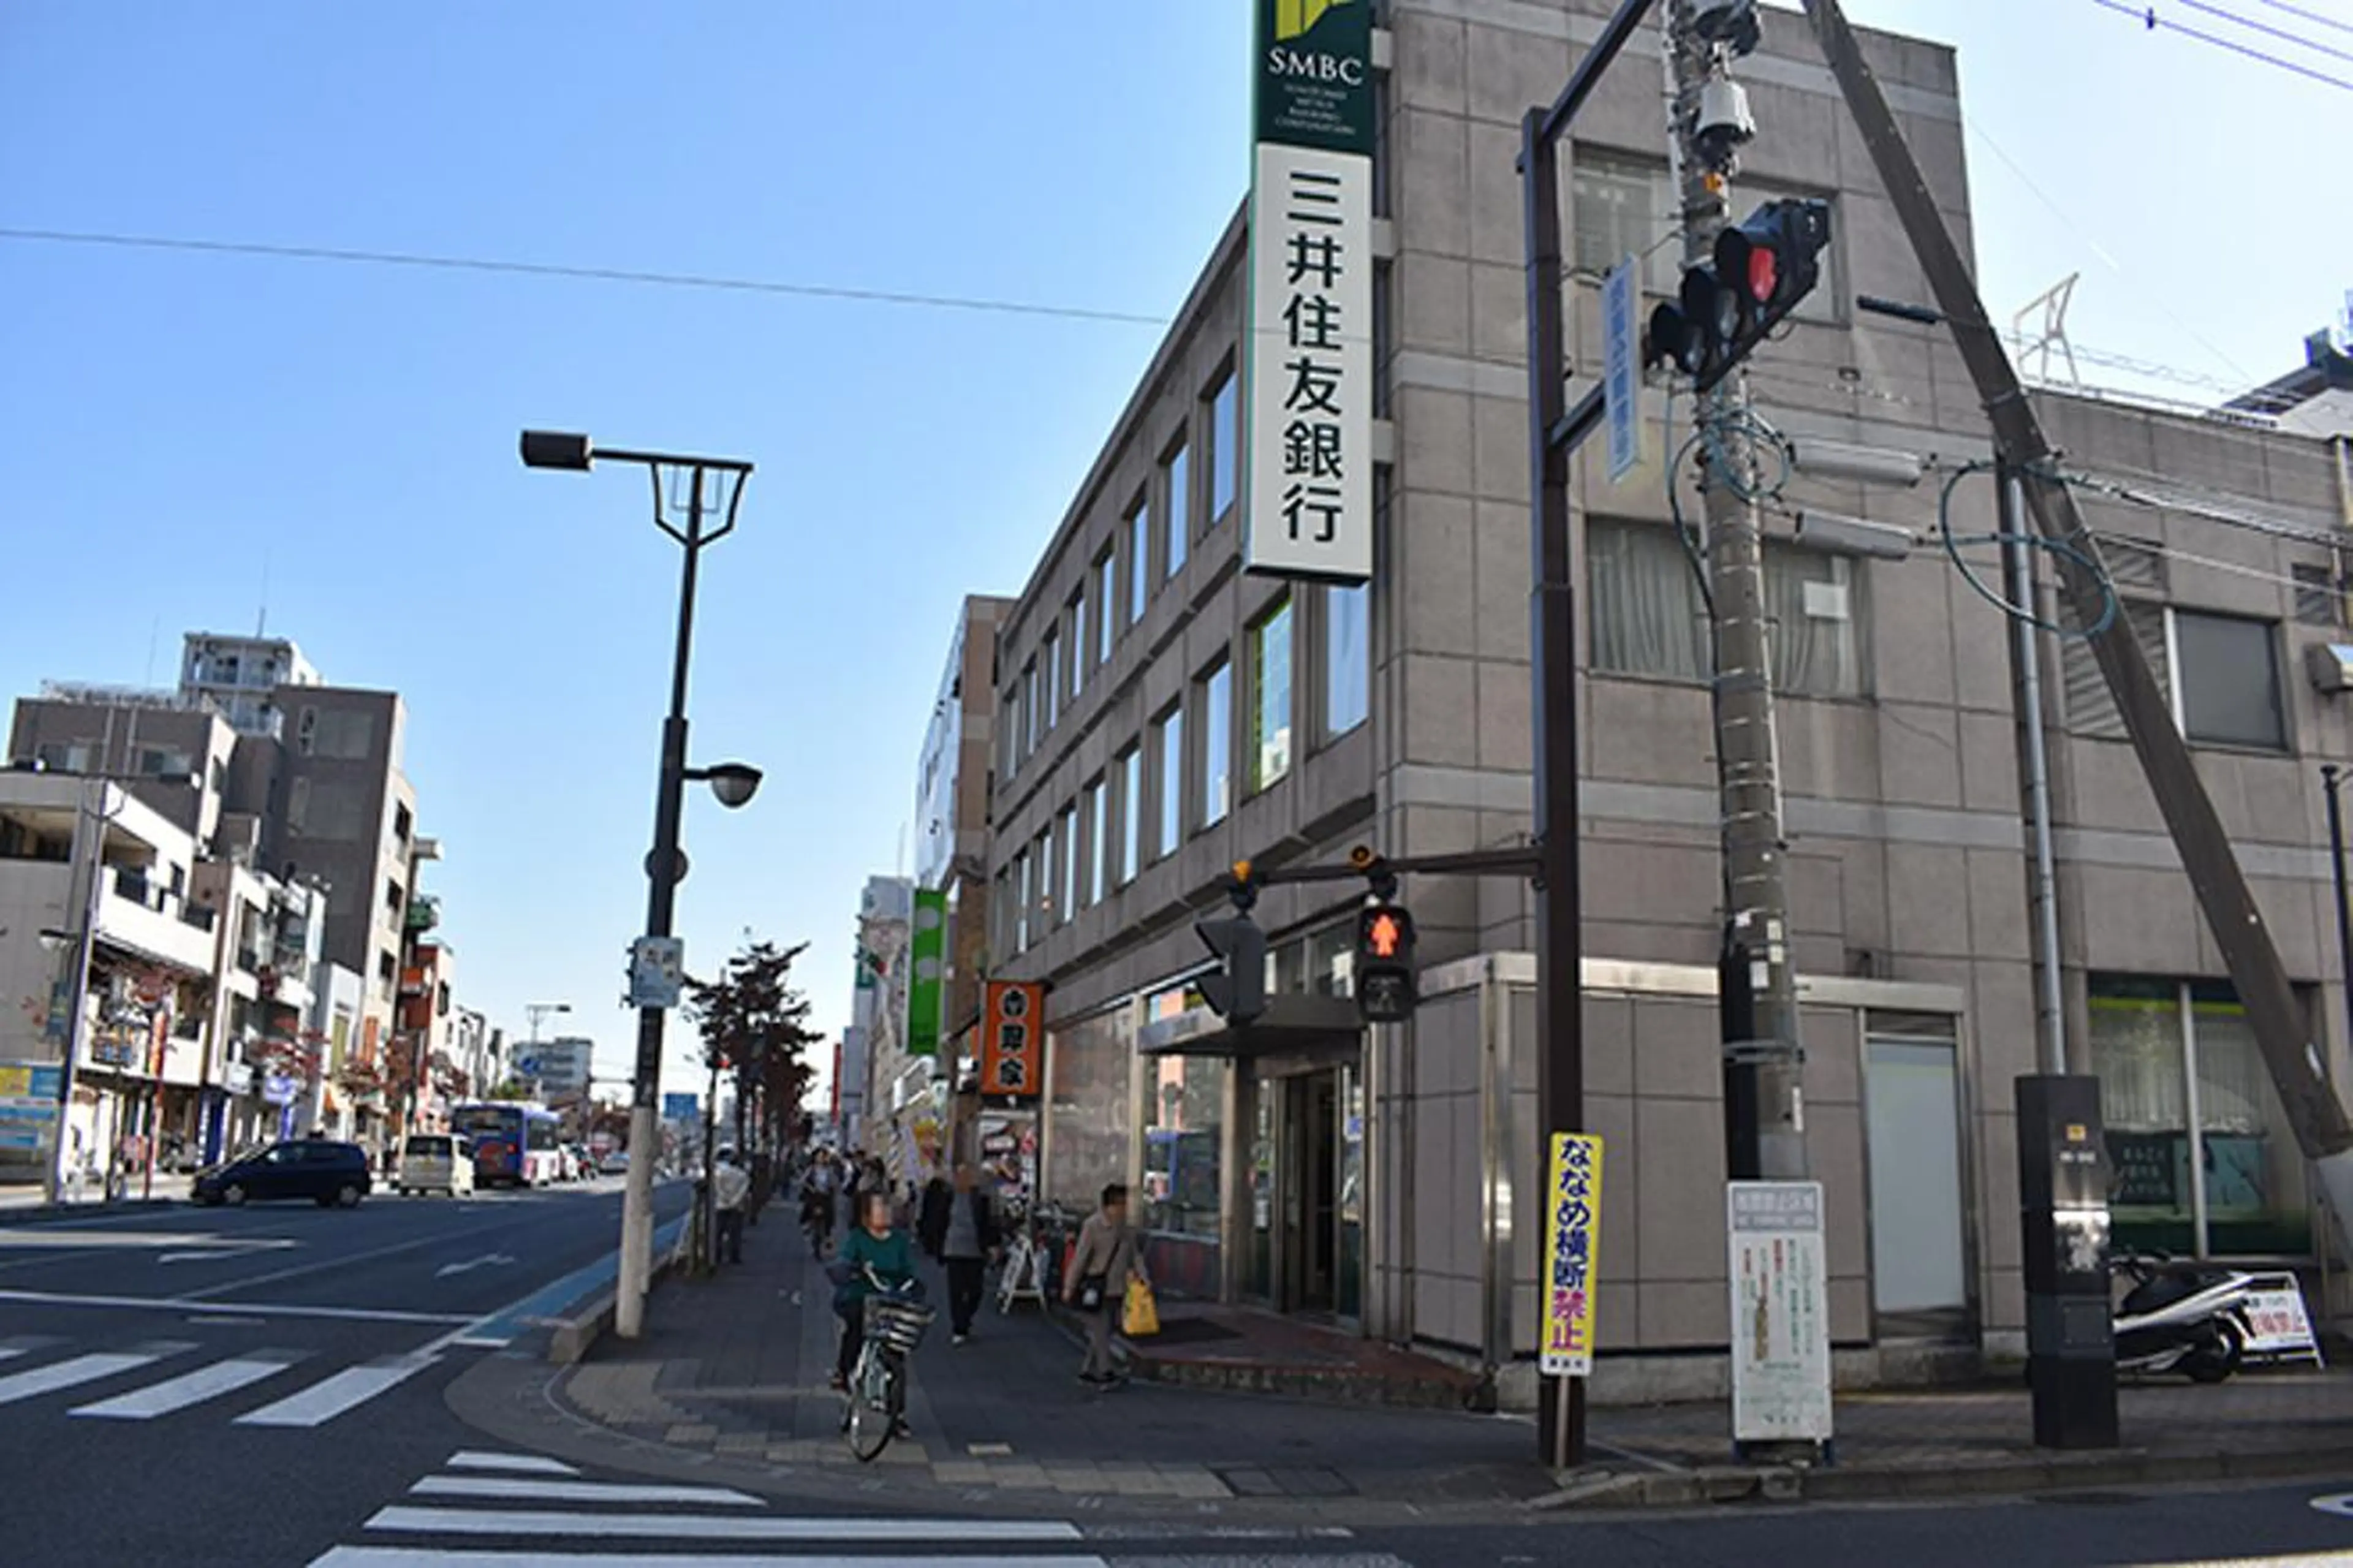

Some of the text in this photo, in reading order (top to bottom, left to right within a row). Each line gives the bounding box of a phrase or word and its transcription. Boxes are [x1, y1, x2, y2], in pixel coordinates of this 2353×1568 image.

[1268, 45, 1363, 86] SMBC
[1282, 171, 1343, 542] 三井住友銀行
[1551, 1138, 1593, 1351] ななめ横断禁止
